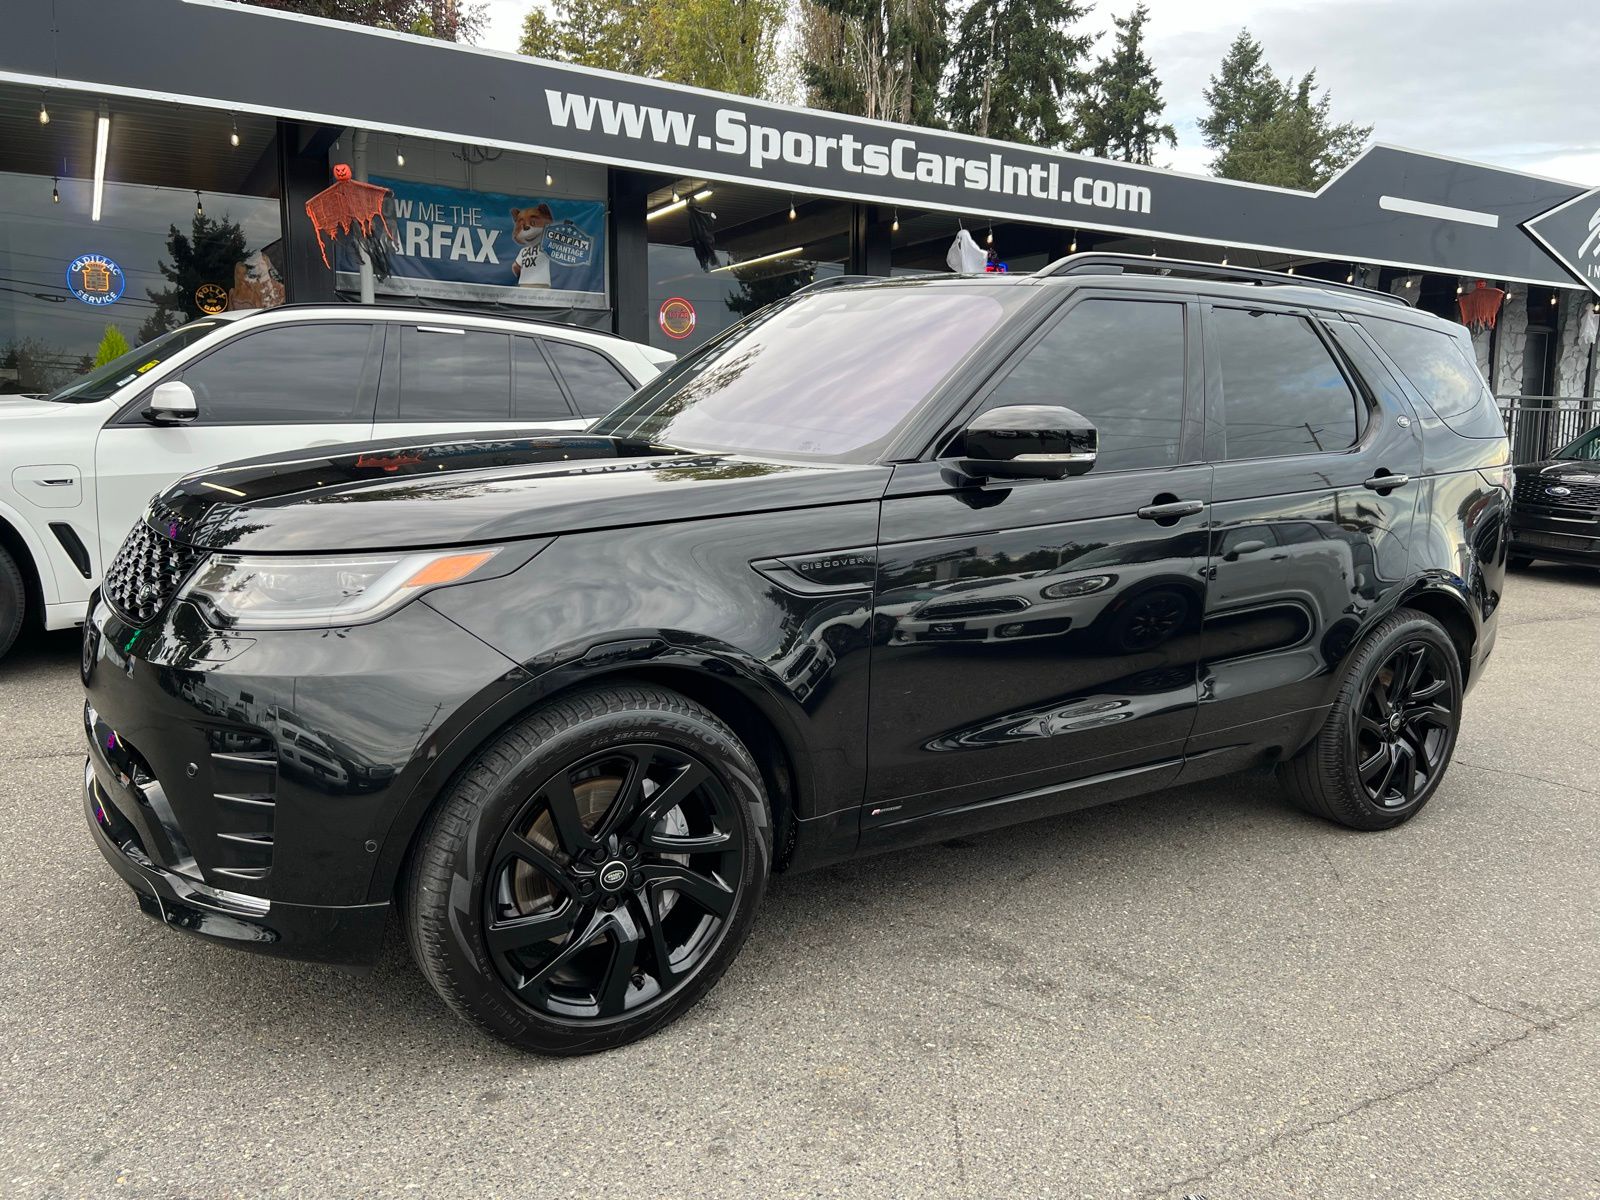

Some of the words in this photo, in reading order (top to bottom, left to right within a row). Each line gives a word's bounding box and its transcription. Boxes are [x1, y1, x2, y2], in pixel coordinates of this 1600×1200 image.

[544, 89, 1150, 213] www.SportsCarsIntl.com
[418, 202, 445, 223] ME
[450, 206, 482, 227] THE
[547, 231, 589, 250] CARFAX
[548, 242, 584, 258] ADVANTAGE
[550, 251, 577, 264] DEALER
[71, 255, 120, 276] CADILLAC
[521, 257, 537, 268] FOX
[76, 289, 118, 304] SERVICE
[801, 556, 872, 571] DISCOVERY
